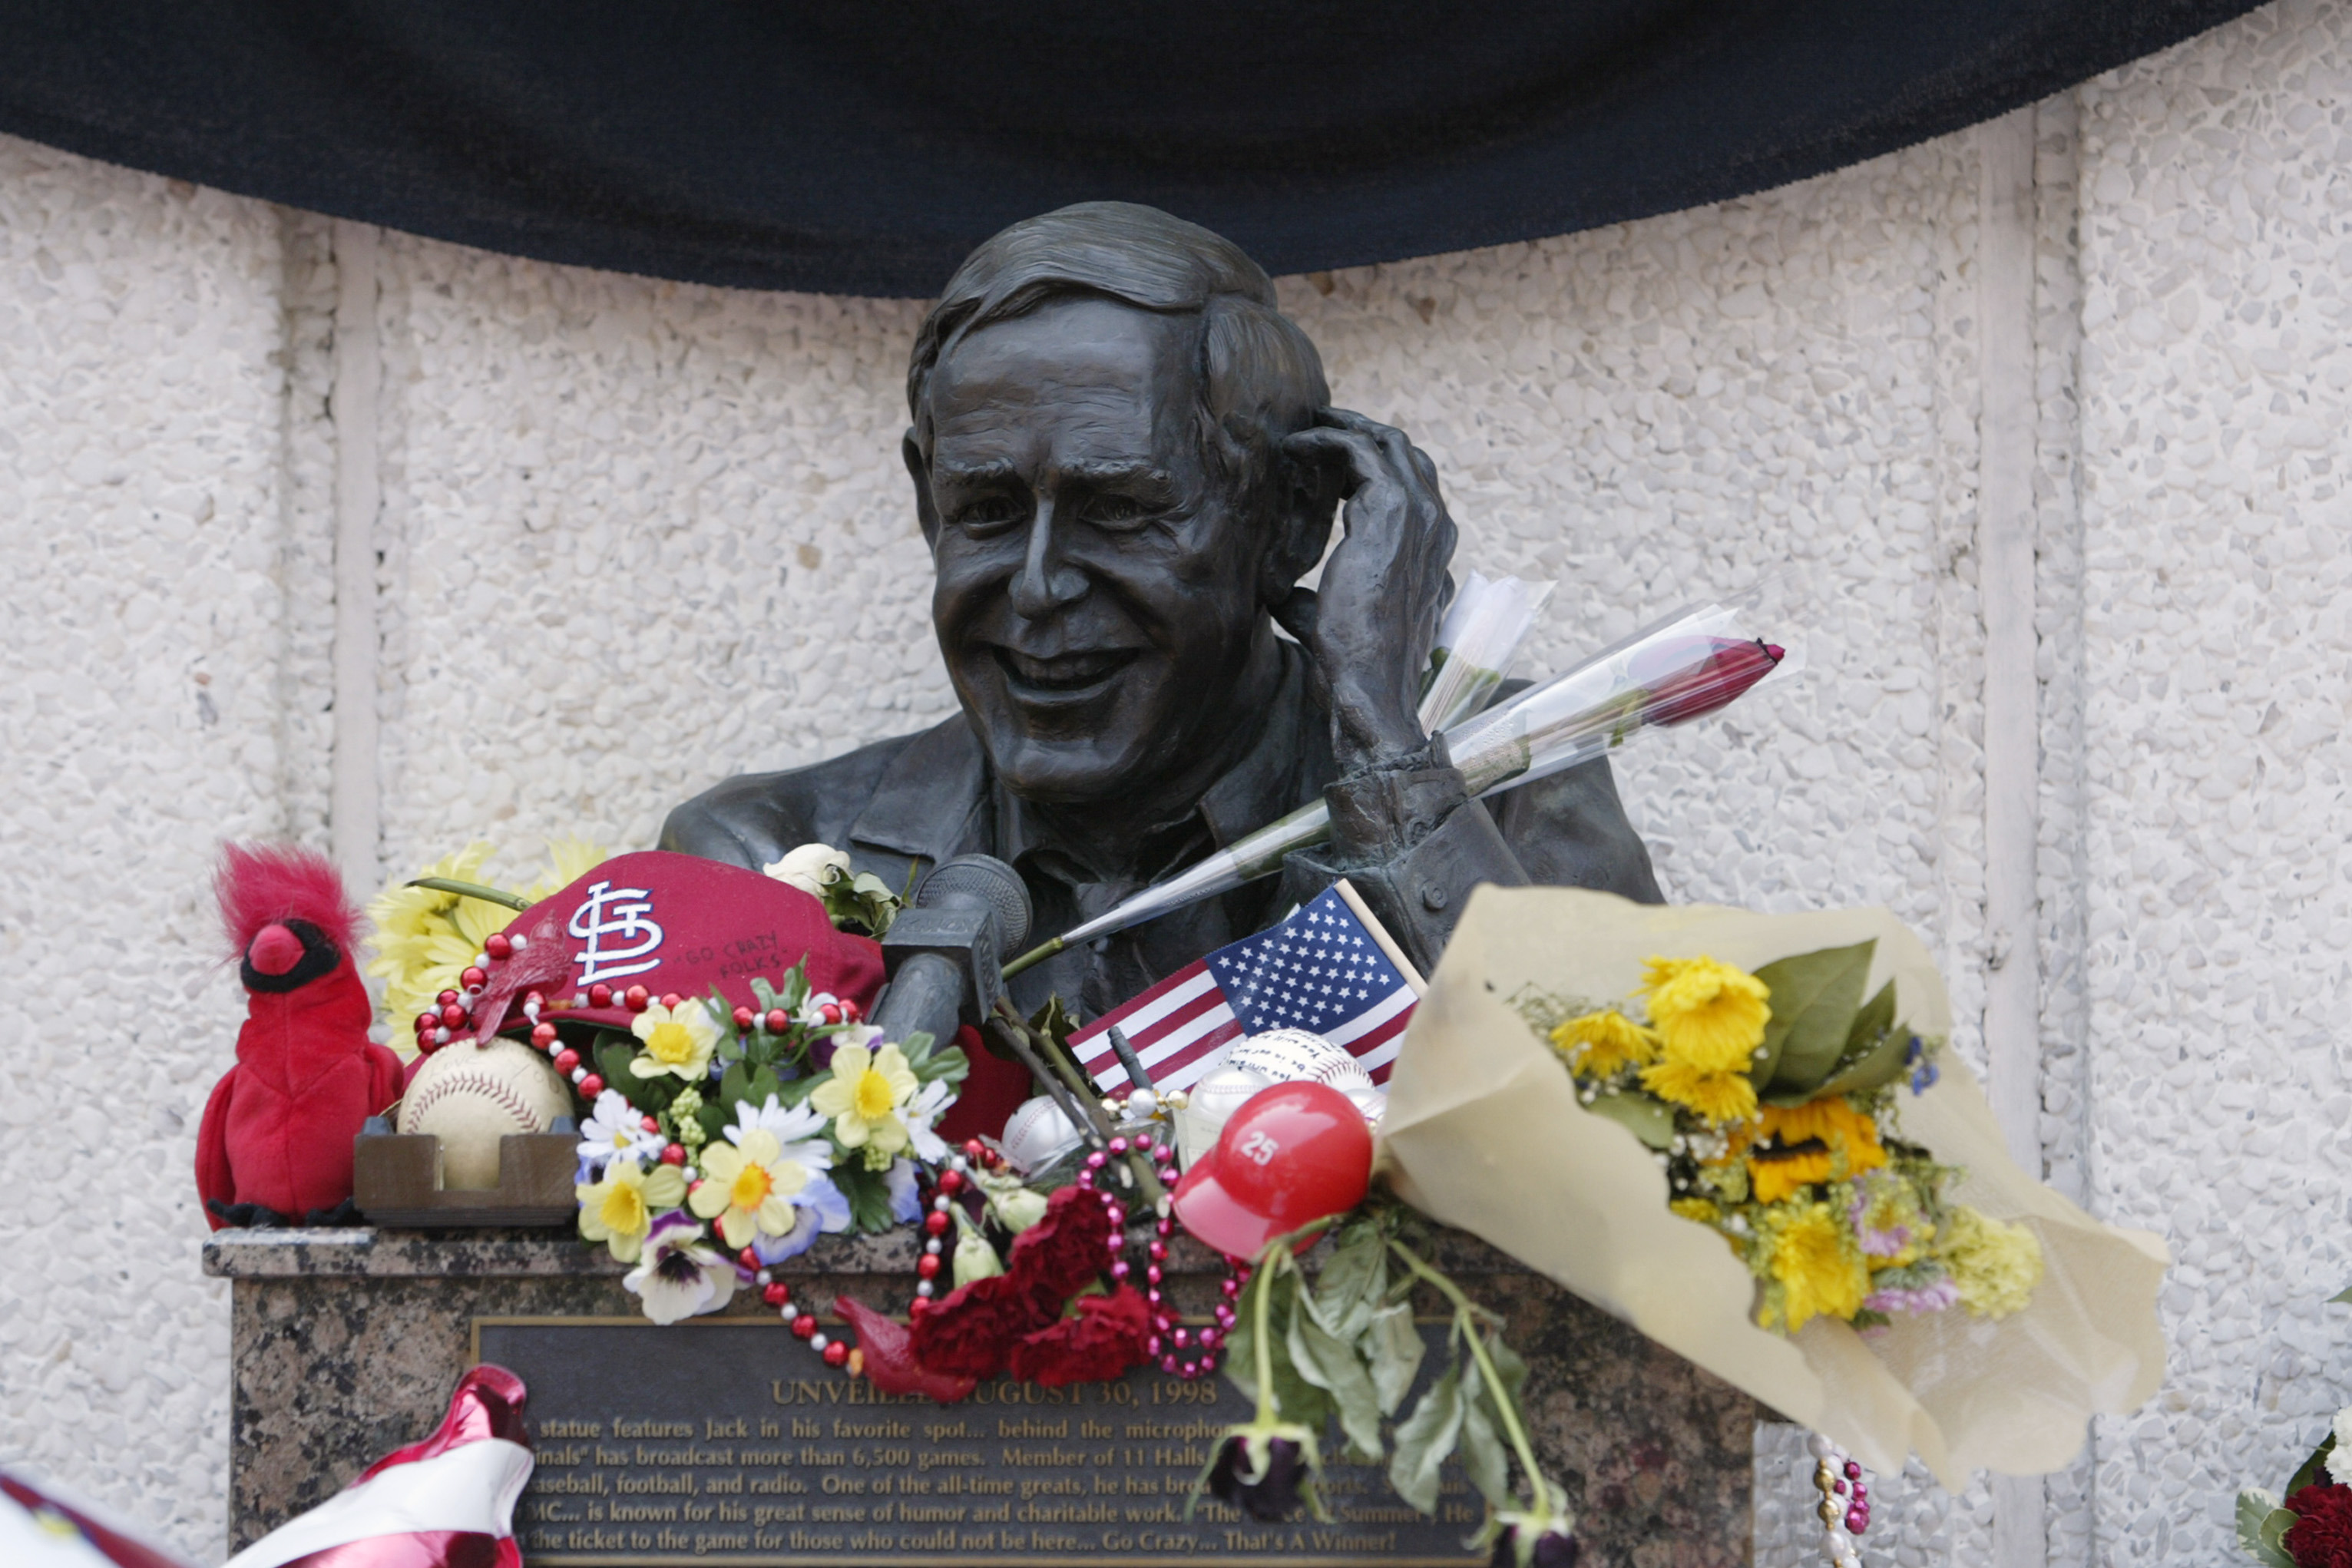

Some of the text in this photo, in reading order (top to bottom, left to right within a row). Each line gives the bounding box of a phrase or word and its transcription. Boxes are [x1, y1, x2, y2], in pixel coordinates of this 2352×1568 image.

[1242, 1131, 1279, 1166] 25
[961, 1380, 1083, 1405] UGUST
[1097, 1381, 1140, 1409] 30,
[1150, 1381, 1218, 1405] 1998
[540, 1417, 1229, 1444] statue features Jack in his favorite spot... behind the micropho
[534, 1444, 1206, 1472] inals" has broadcast more than 6,500 games. Member of 11 Halls
[531, 1472, 610, 1497] aseball,
[616, 1472, 700, 1497] football,
[706, 1472, 743, 1494] and
[749, 1472, 809, 1494] radio.
[822, 1474, 865, 1494] One
[872, 1474, 893, 1494] of
[898, 1474, 931, 1494] the
[937, 1474, 1014, 1494] all-time
[1020, 1477, 1089, 1500] greats,
[1093, 1474, 1119, 1495] he
[1125, 1474, 1159, 1495] has
[587, 1500, 604, 1522] is
[610, 1500, 677, 1522] known
[683, 1500, 714, 1522] for
[719, 1500, 748, 1522] his
[753, 1503, 805, 1527] great
[812, 1506, 866, 1523] sense
[872, 1500, 895, 1522] of
[899, 1500, 967, 1523] humor
[972, 1501, 1011, 1523] and
[1017, 1501, 1118, 1523] charitable
[1125, 1501, 1183, 1523] work.
[1196, 1502, 1242, 1523] "The
[1444, 1502, 1475, 1523] He
[531, 1528, 563, 1550] the
[568, 1528, 625, 1550] ticket
[630, 1530, 653, 1550] to
[657, 1528, 690, 1550] the
[694, 1533, 749, 1556] game
[754, 1528, 785, 1550] for
[789, 1529, 844, 1550] those
[849, 1529, 894, 1550] who
[899, 1529, 958, 1550] could
[961, 1532, 995, 1550] not
[1001, 1529, 1027, 1550] be
[1032, 1529, 1097, 1551] here...
[1102, 1530, 1134, 1551] Go
[1139, 1530, 1218, 1556] Crazy...
[1224, 1530, 1284, 1551] That's
[1289, 1531, 1305, 1551] A
[1311, 1530, 1397, 1552] Winner!
